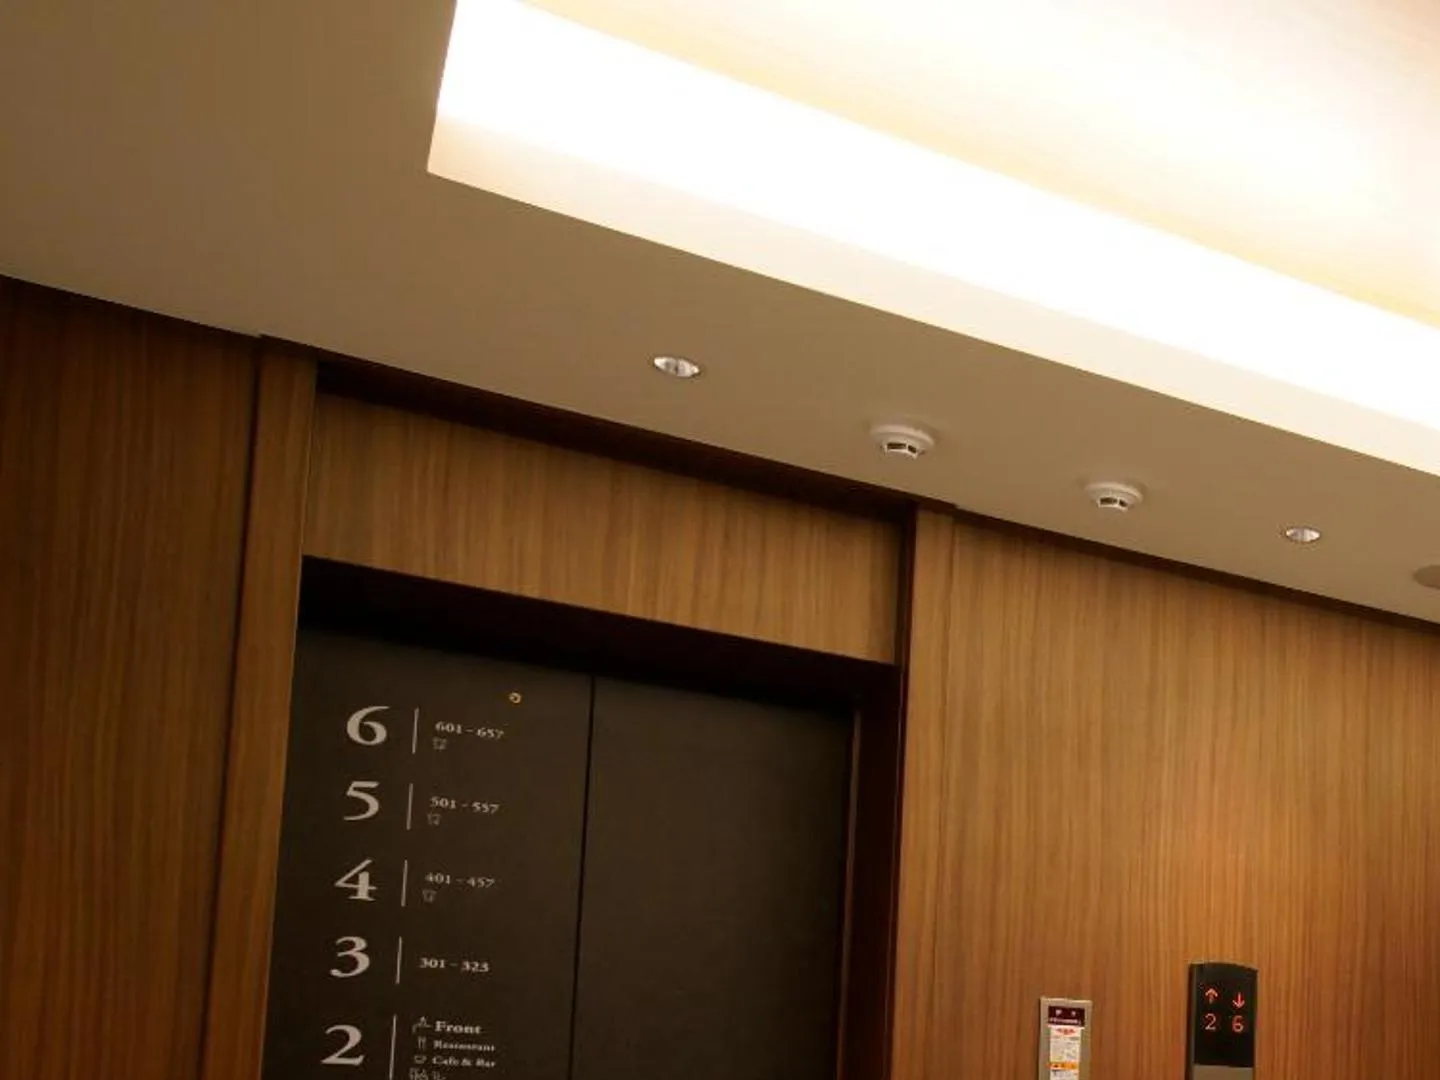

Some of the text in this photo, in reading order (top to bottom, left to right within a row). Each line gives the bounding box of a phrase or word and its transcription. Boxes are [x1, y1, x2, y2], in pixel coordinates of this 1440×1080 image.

[346, 705, 390, 746] 6
[343, 780, 380, 821] 5
[334, 858, 377, 901] 4
[330, 935, 371, 979] 3
[435, 1020, 482, 1034] Front
[1204, 1012, 1245, 1033] 2 6
[320, 1024, 366, 1066] 2
